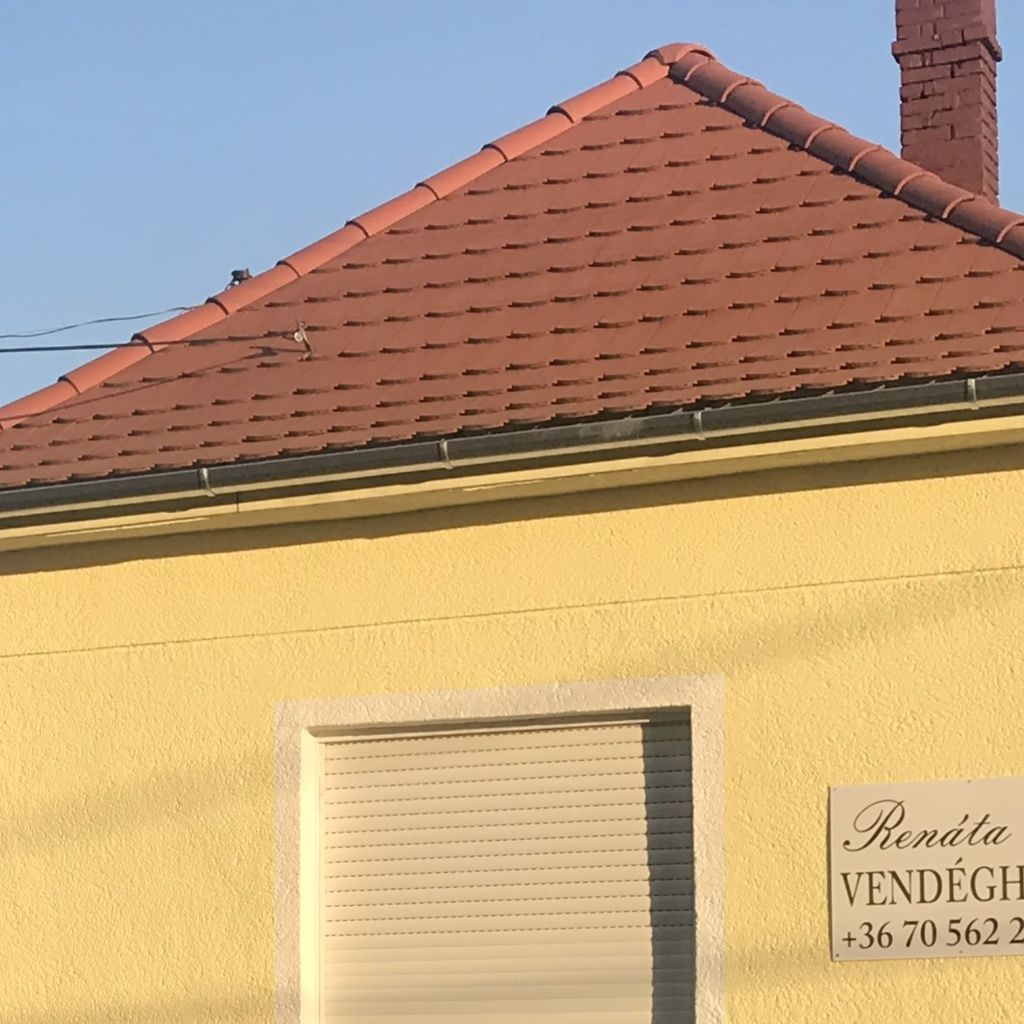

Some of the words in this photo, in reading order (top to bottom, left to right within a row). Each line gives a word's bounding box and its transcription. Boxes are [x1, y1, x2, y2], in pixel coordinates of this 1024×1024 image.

[842, 799, 1012, 852] Renáta
[840, 857, 1024, 907] VENDÉGH
[842, 921, 893, 949] +36
[902, 919, 937, 947] 70
[946, 917, 999, 946] 562
